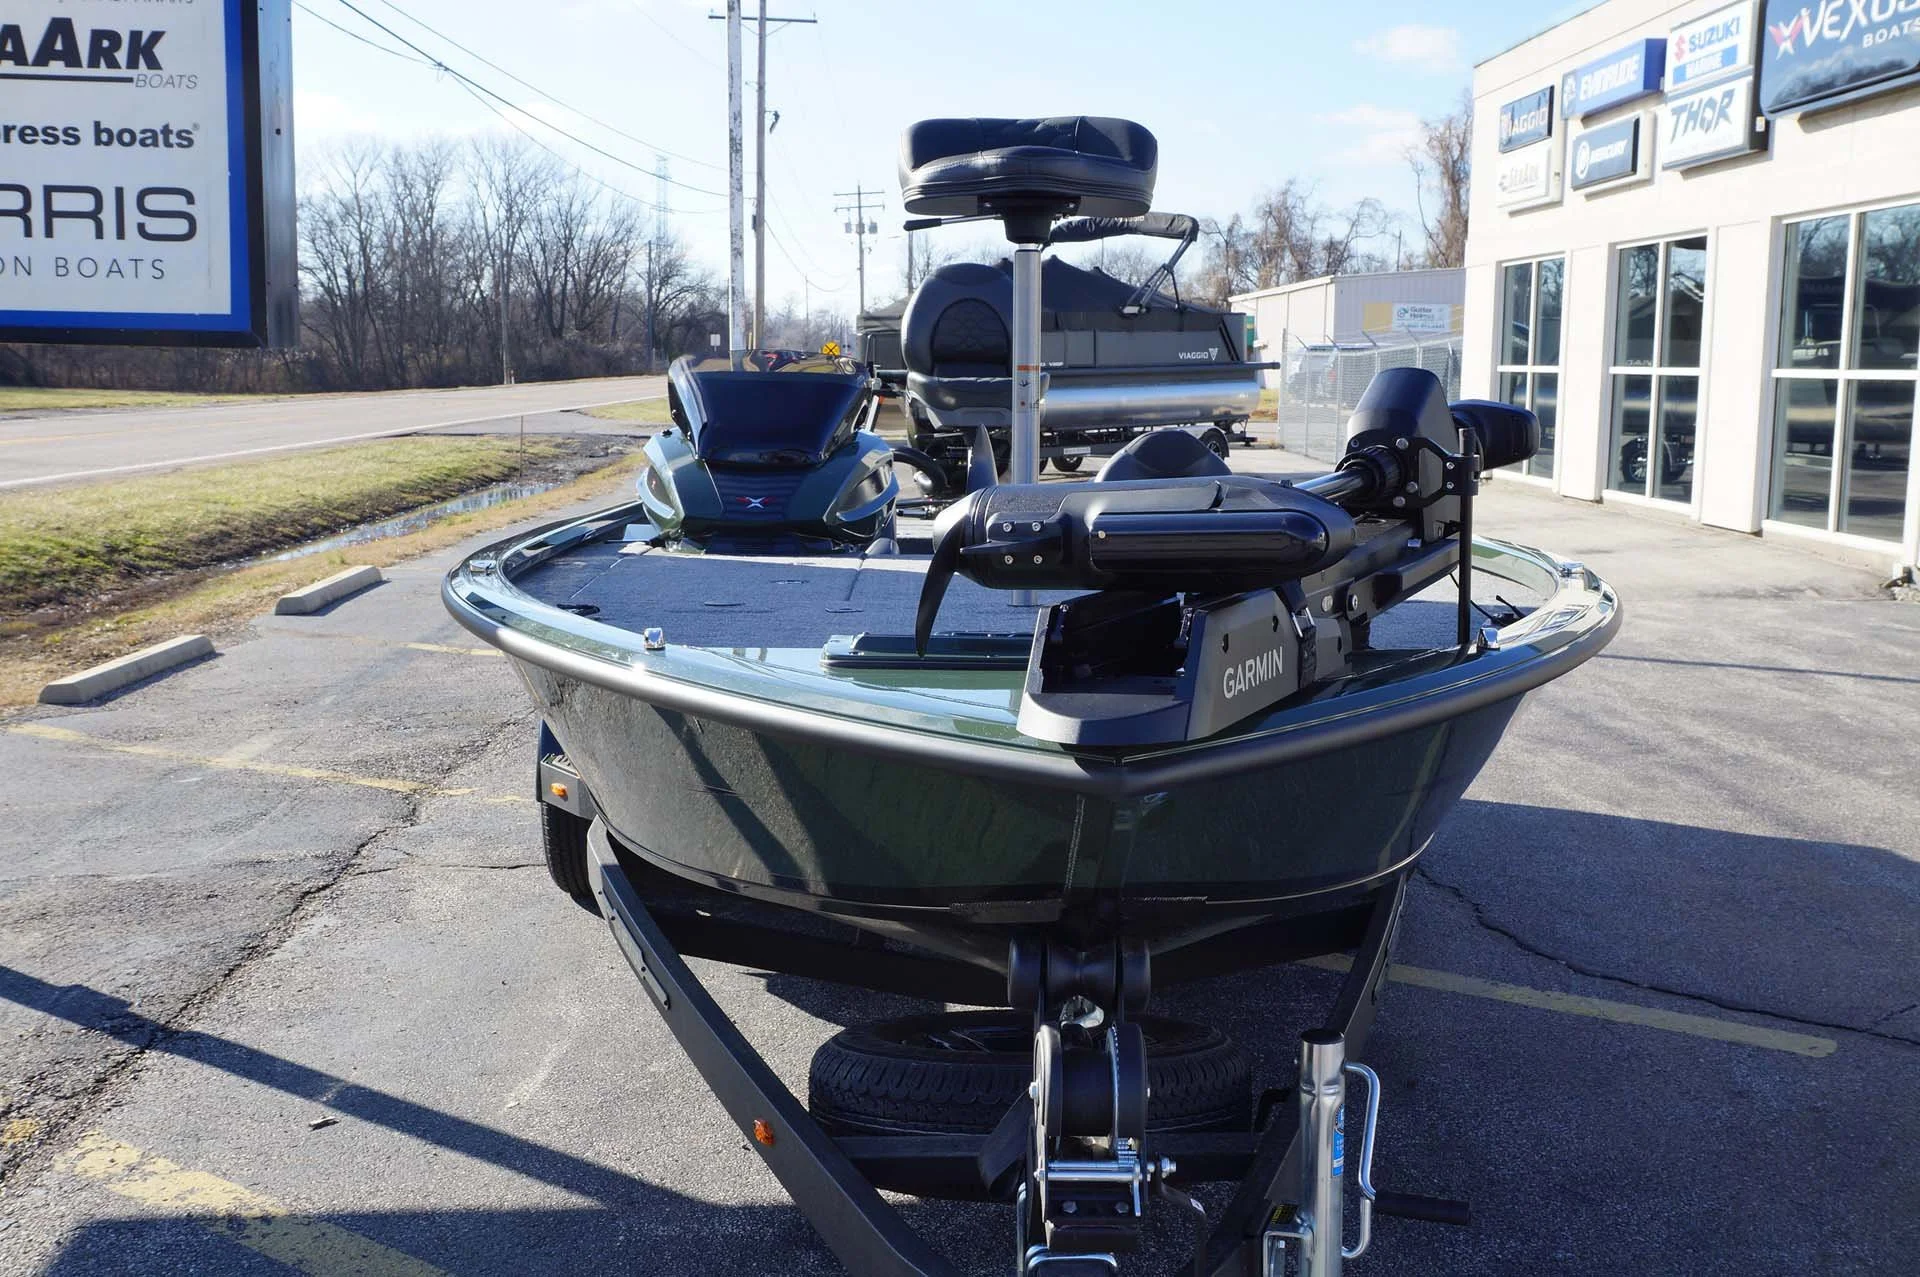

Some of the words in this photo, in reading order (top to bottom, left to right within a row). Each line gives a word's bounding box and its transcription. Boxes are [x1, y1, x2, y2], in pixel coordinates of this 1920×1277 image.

[1688, 16, 1741, 53] SUZUKI
[135, 73, 198, 90] BOATS
[1670, 88, 1736, 144] THOR
[0, 123, 81, 146] ress
[0, 255, 32, 277] N
[55, 256, 165, 280] BOATS
[1178, 351, 1209, 360] VIAGGIO
[1223, 646, 1283, 699] GARMIN
